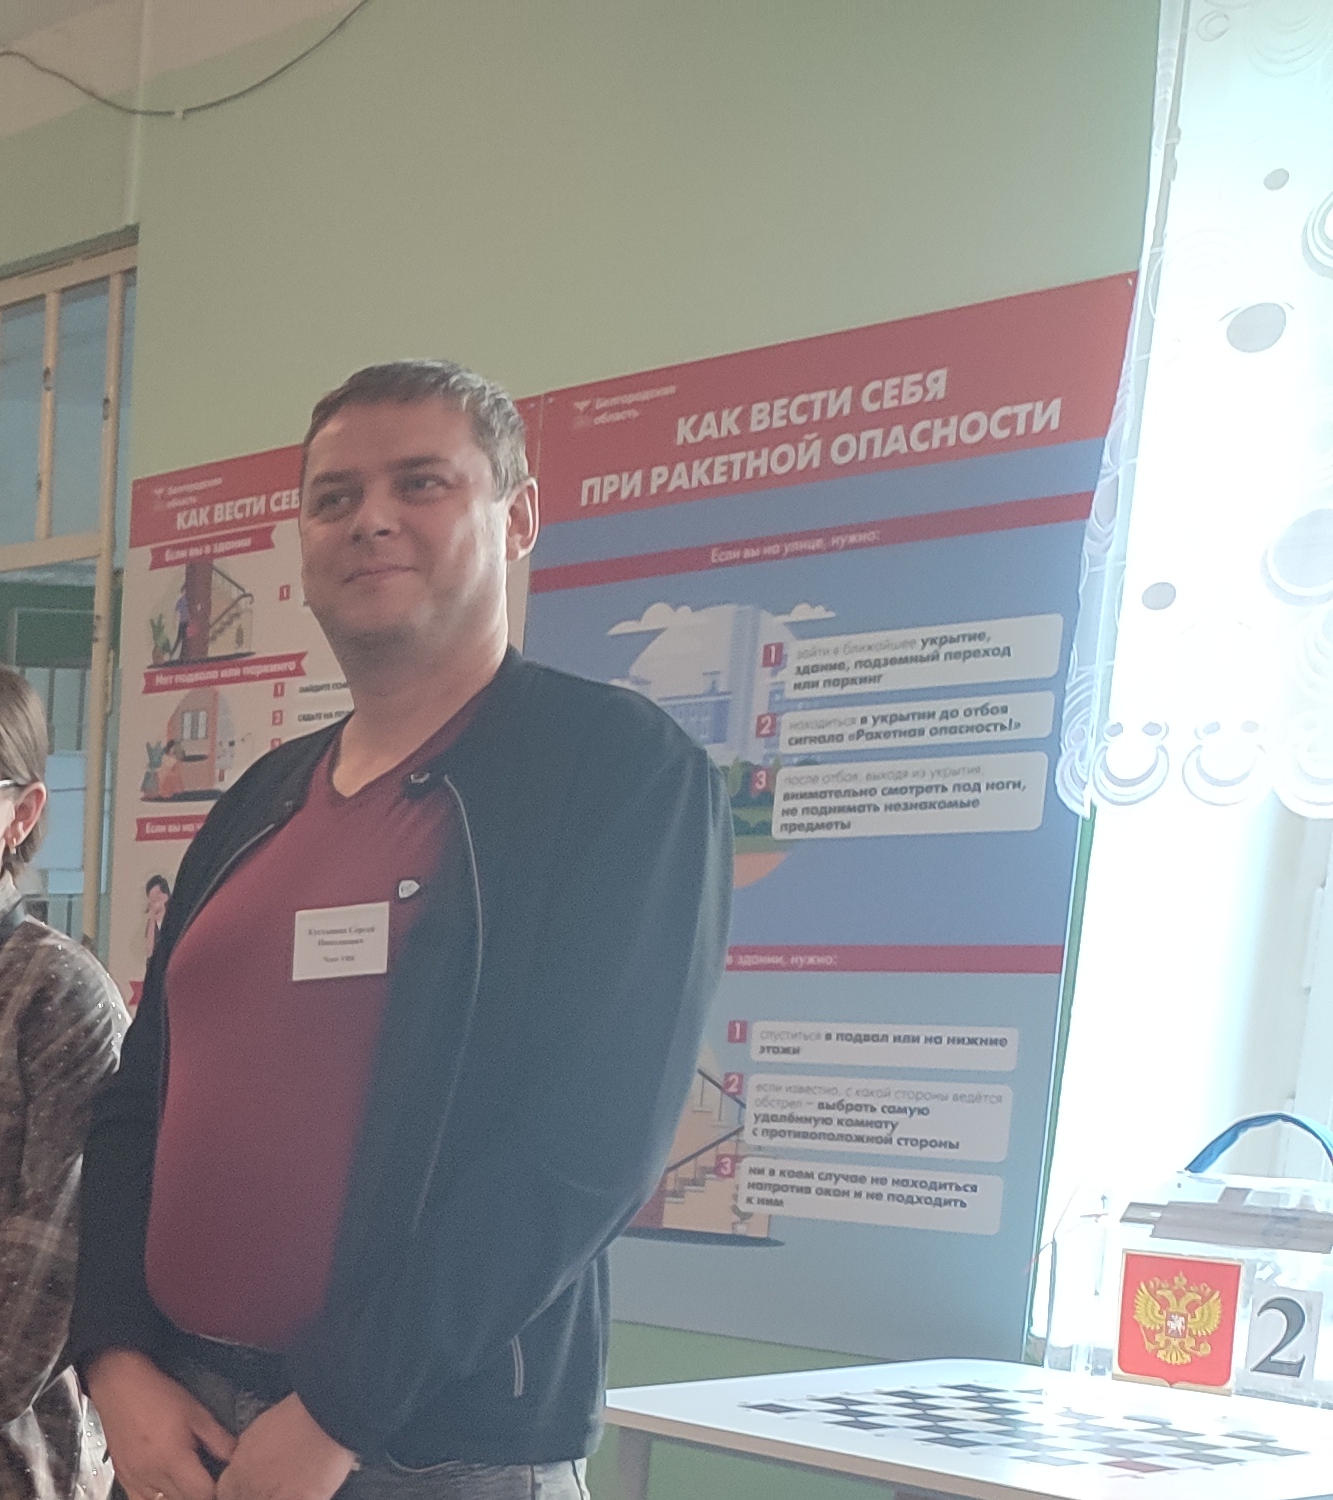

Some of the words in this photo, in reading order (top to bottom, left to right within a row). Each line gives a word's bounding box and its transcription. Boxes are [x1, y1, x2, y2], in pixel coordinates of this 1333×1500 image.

[676, 406, 743, 446] КАК
[749, 386, 853, 432] ВЕСТИ
[861, 367, 948, 412] СЕБЯ
[581, 469, 643, 507] ПРИ
[650, 433, 822, 495] РАКЕТНОЙ
[830, 397, 1062, 465] ОПАСНОСТИ
[177, 506, 210, 531] КАК
[214, 495, 266, 523] ВЕСТИ
[270, 487, 300, 512] СЕБ
[711, 548, 740, 563] Если
[920, 630, 991, 650] укрытие,
[794, 661, 850, 676] здание,
[854, 651, 940, 670] подземный
[943, 646, 1012, 663] переход
[793, 680, 820, 691] или
[823, 674, 883, 691] паркинг
[759, 718, 771, 734] 2
[860, 716, 868, 725] в
[872, 709, 936, 726] укрытии
[940, 707, 959, 721] до
[963, 702, 1009, 718] отбоя
[787, 732, 844, 746] сигнала
[755, 771, 767, 790] 3
[783, 786, 877, 801] внимательно
[881, 783, 948, 798] смотреть
[952, 781, 982, 795] под
[985, 778, 1027, 792] ноги,
[781, 807, 798, 817] не
[801, 803, 880, 818] поднимать
[884, 798, 980, 812] незнакомые
[780, 819, 851, 834] предметы
[790, 953, 838, 968] нужно:
[759, 1044, 800, 1055] этажи
[824, 1033, 832, 1041] в
[836, 1032, 889, 1045] подвал
[893, 1034, 920, 1044] или
[924, 1035, 943, 1045] на
[946, 1036, 1008, 1048] нижние
[727, 1076, 739, 1092] 2
[817, 1099, 877, 1113] выбрать
[881, 1104, 930, 1118] самую
[753, 1111, 833, 1128] удалённую
[836, 1117, 899, 1133] комнату
[761, 1128, 893, 1146] противоположной
[896, 1137, 960, 1150] стороны
[719, 1159, 732, 1175] 3
[748, 1166, 765, 1176] ни
[768, 1167, 776, 1177] в
[779, 1169, 815, 1181] коем
[817, 1171, 867, 1185] случае
[870, 1176, 888, 1187] не
[891, 1176, 978, 1193] находиться
[747, 1180, 811, 1195] напротив
[815, 1187, 850, 1198] окон
[853, 1190, 863, 1199] и
[866, 1190, 883, 1200] не
[887, 1191, 967, 1209] подходить
[757, 1196, 784, 1207] ним
[1249, 1295, 1306, 1378] 2
